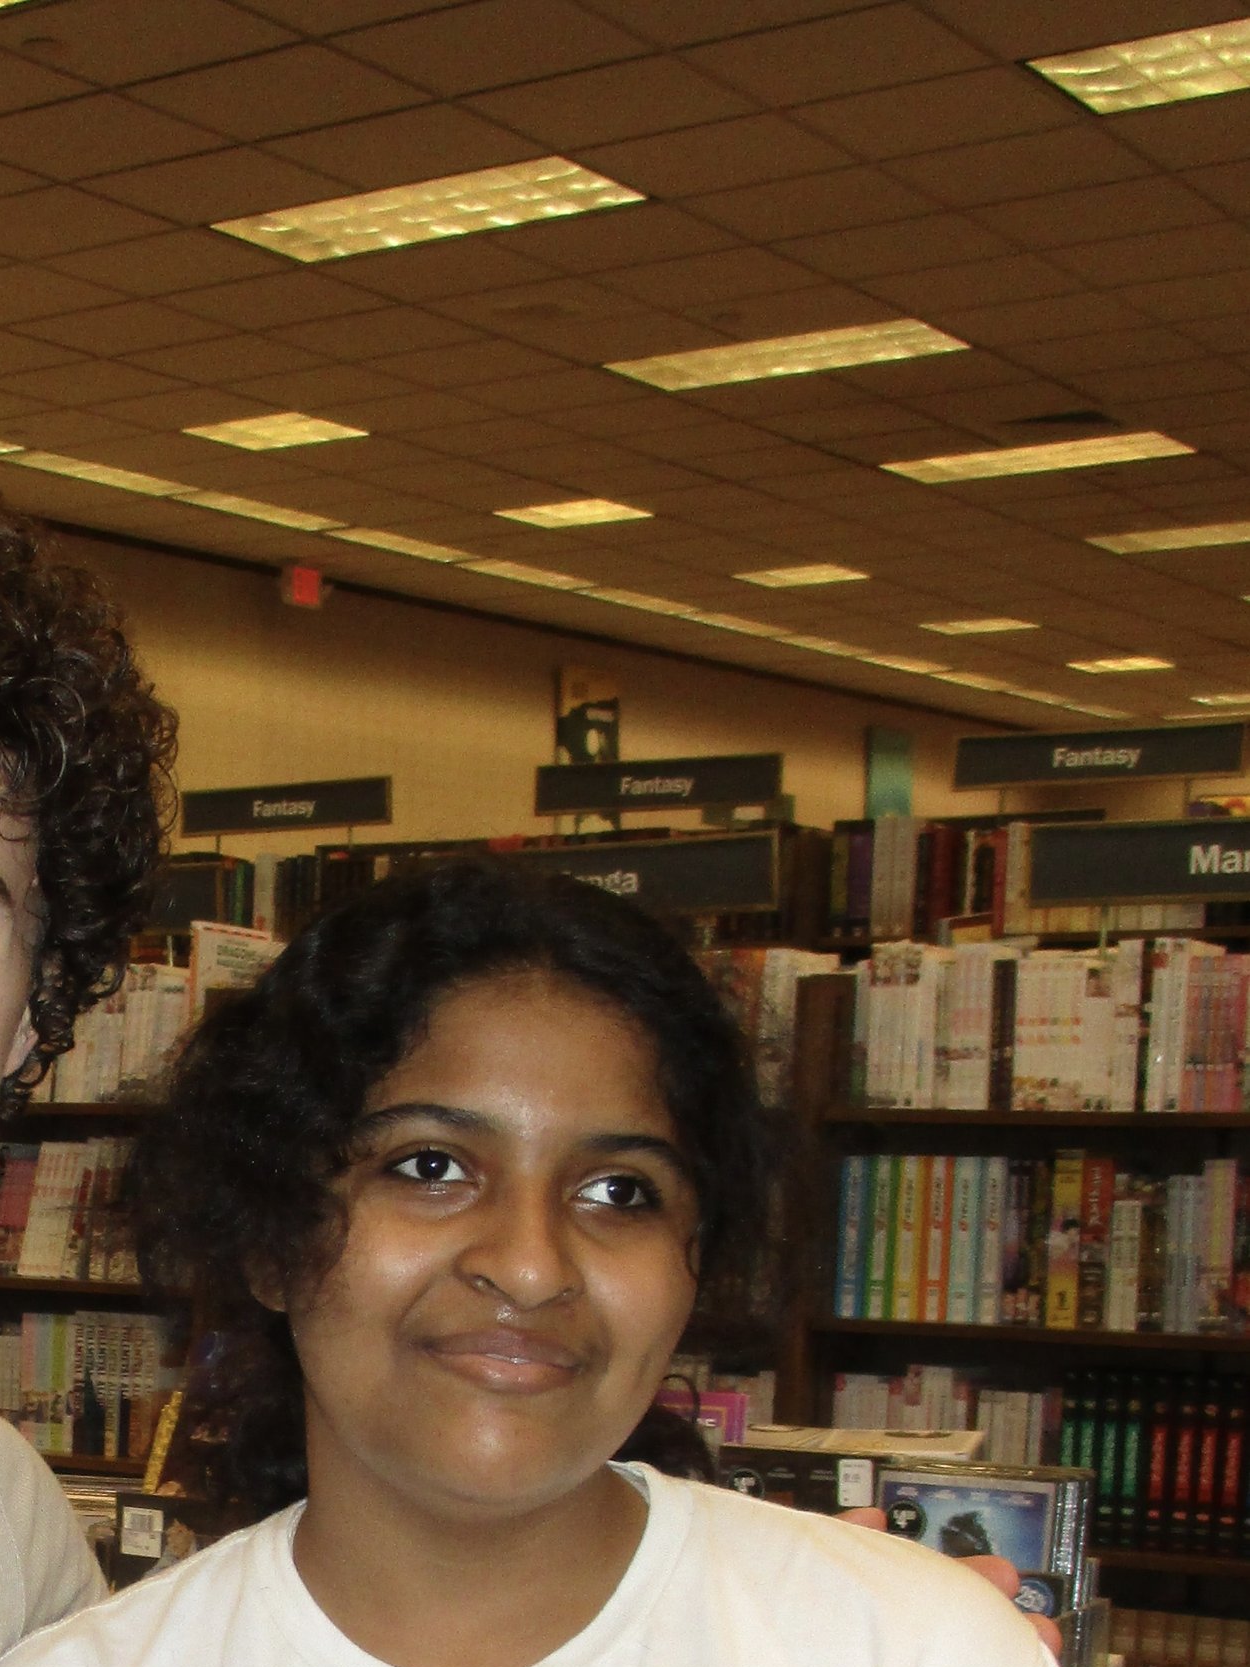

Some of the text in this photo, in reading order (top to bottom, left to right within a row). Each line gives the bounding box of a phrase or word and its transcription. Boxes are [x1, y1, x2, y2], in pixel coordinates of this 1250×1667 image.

[1053, 743, 1141, 769] Fantasy
[621, 776, 694, 797] Fantasy
[252, 799, 317, 818] Fantasy
